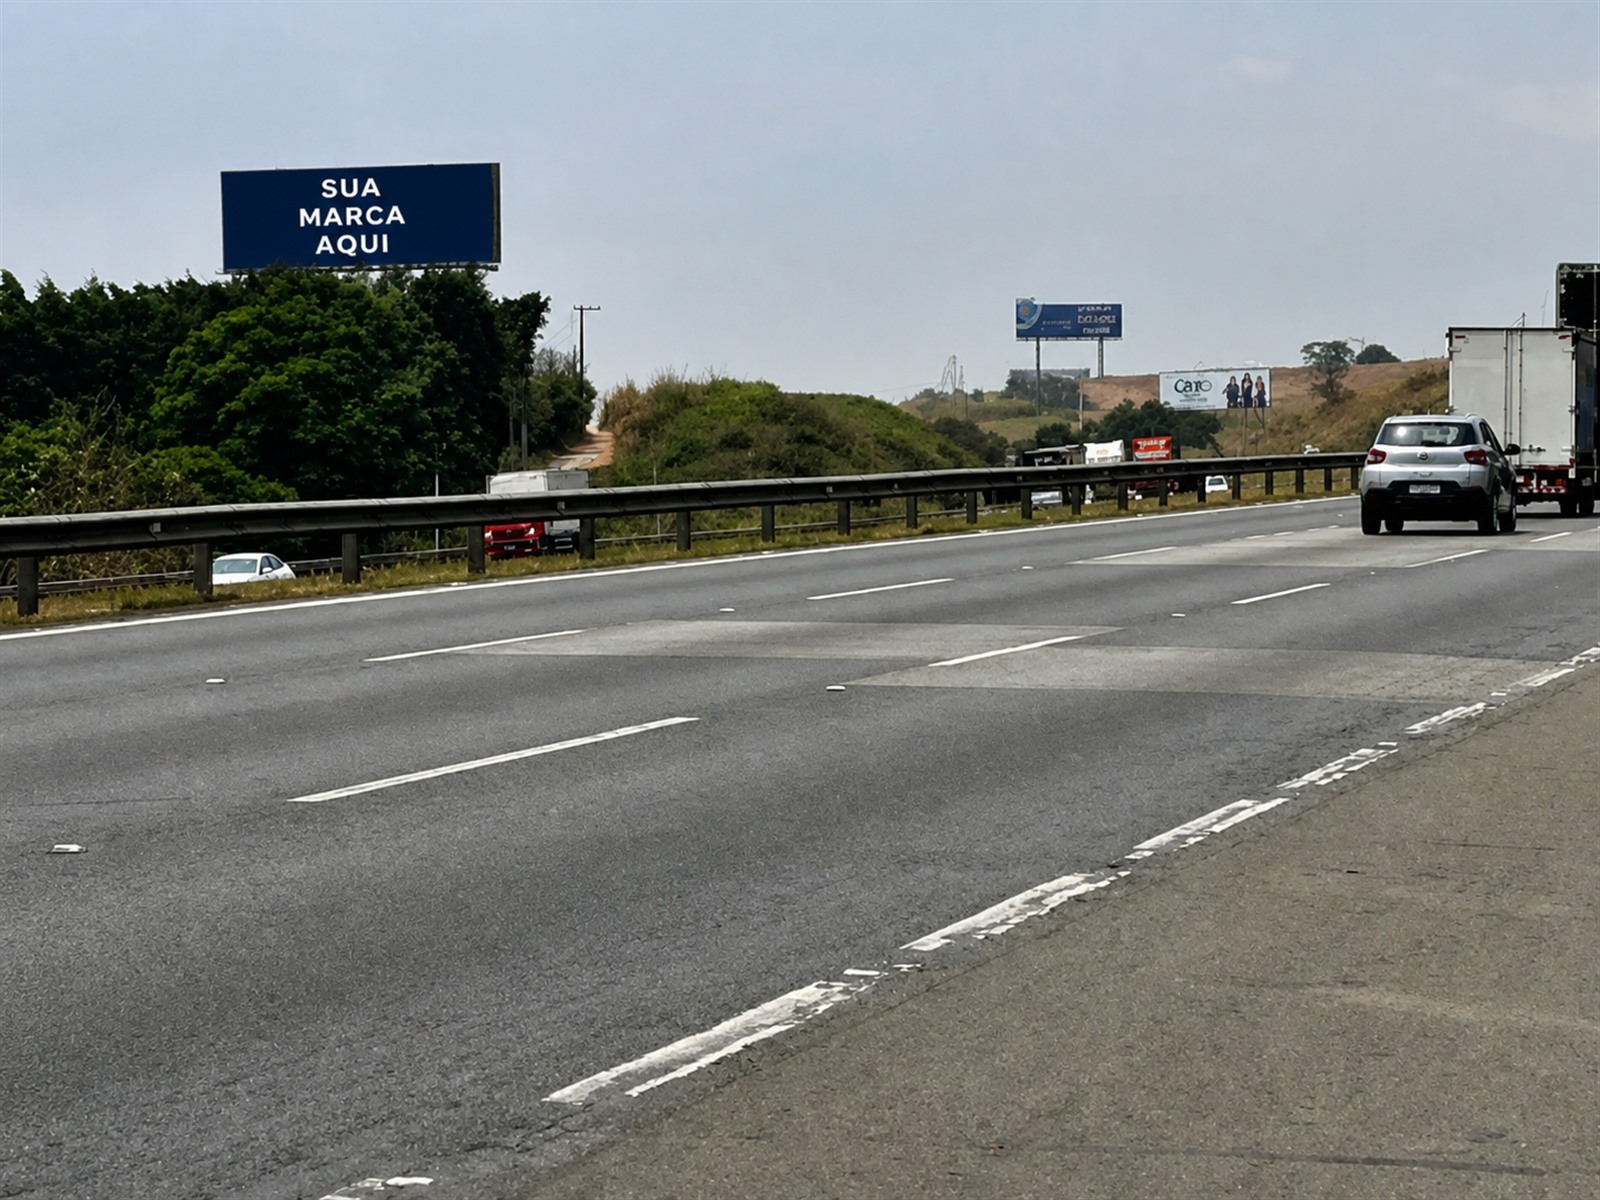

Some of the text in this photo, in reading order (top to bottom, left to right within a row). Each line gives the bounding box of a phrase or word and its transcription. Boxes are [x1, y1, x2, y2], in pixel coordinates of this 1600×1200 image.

[321, 177, 381, 199] SUA
[299, 205, 406, 227] MARCA
[315, 233, 389, 257] AQUI
